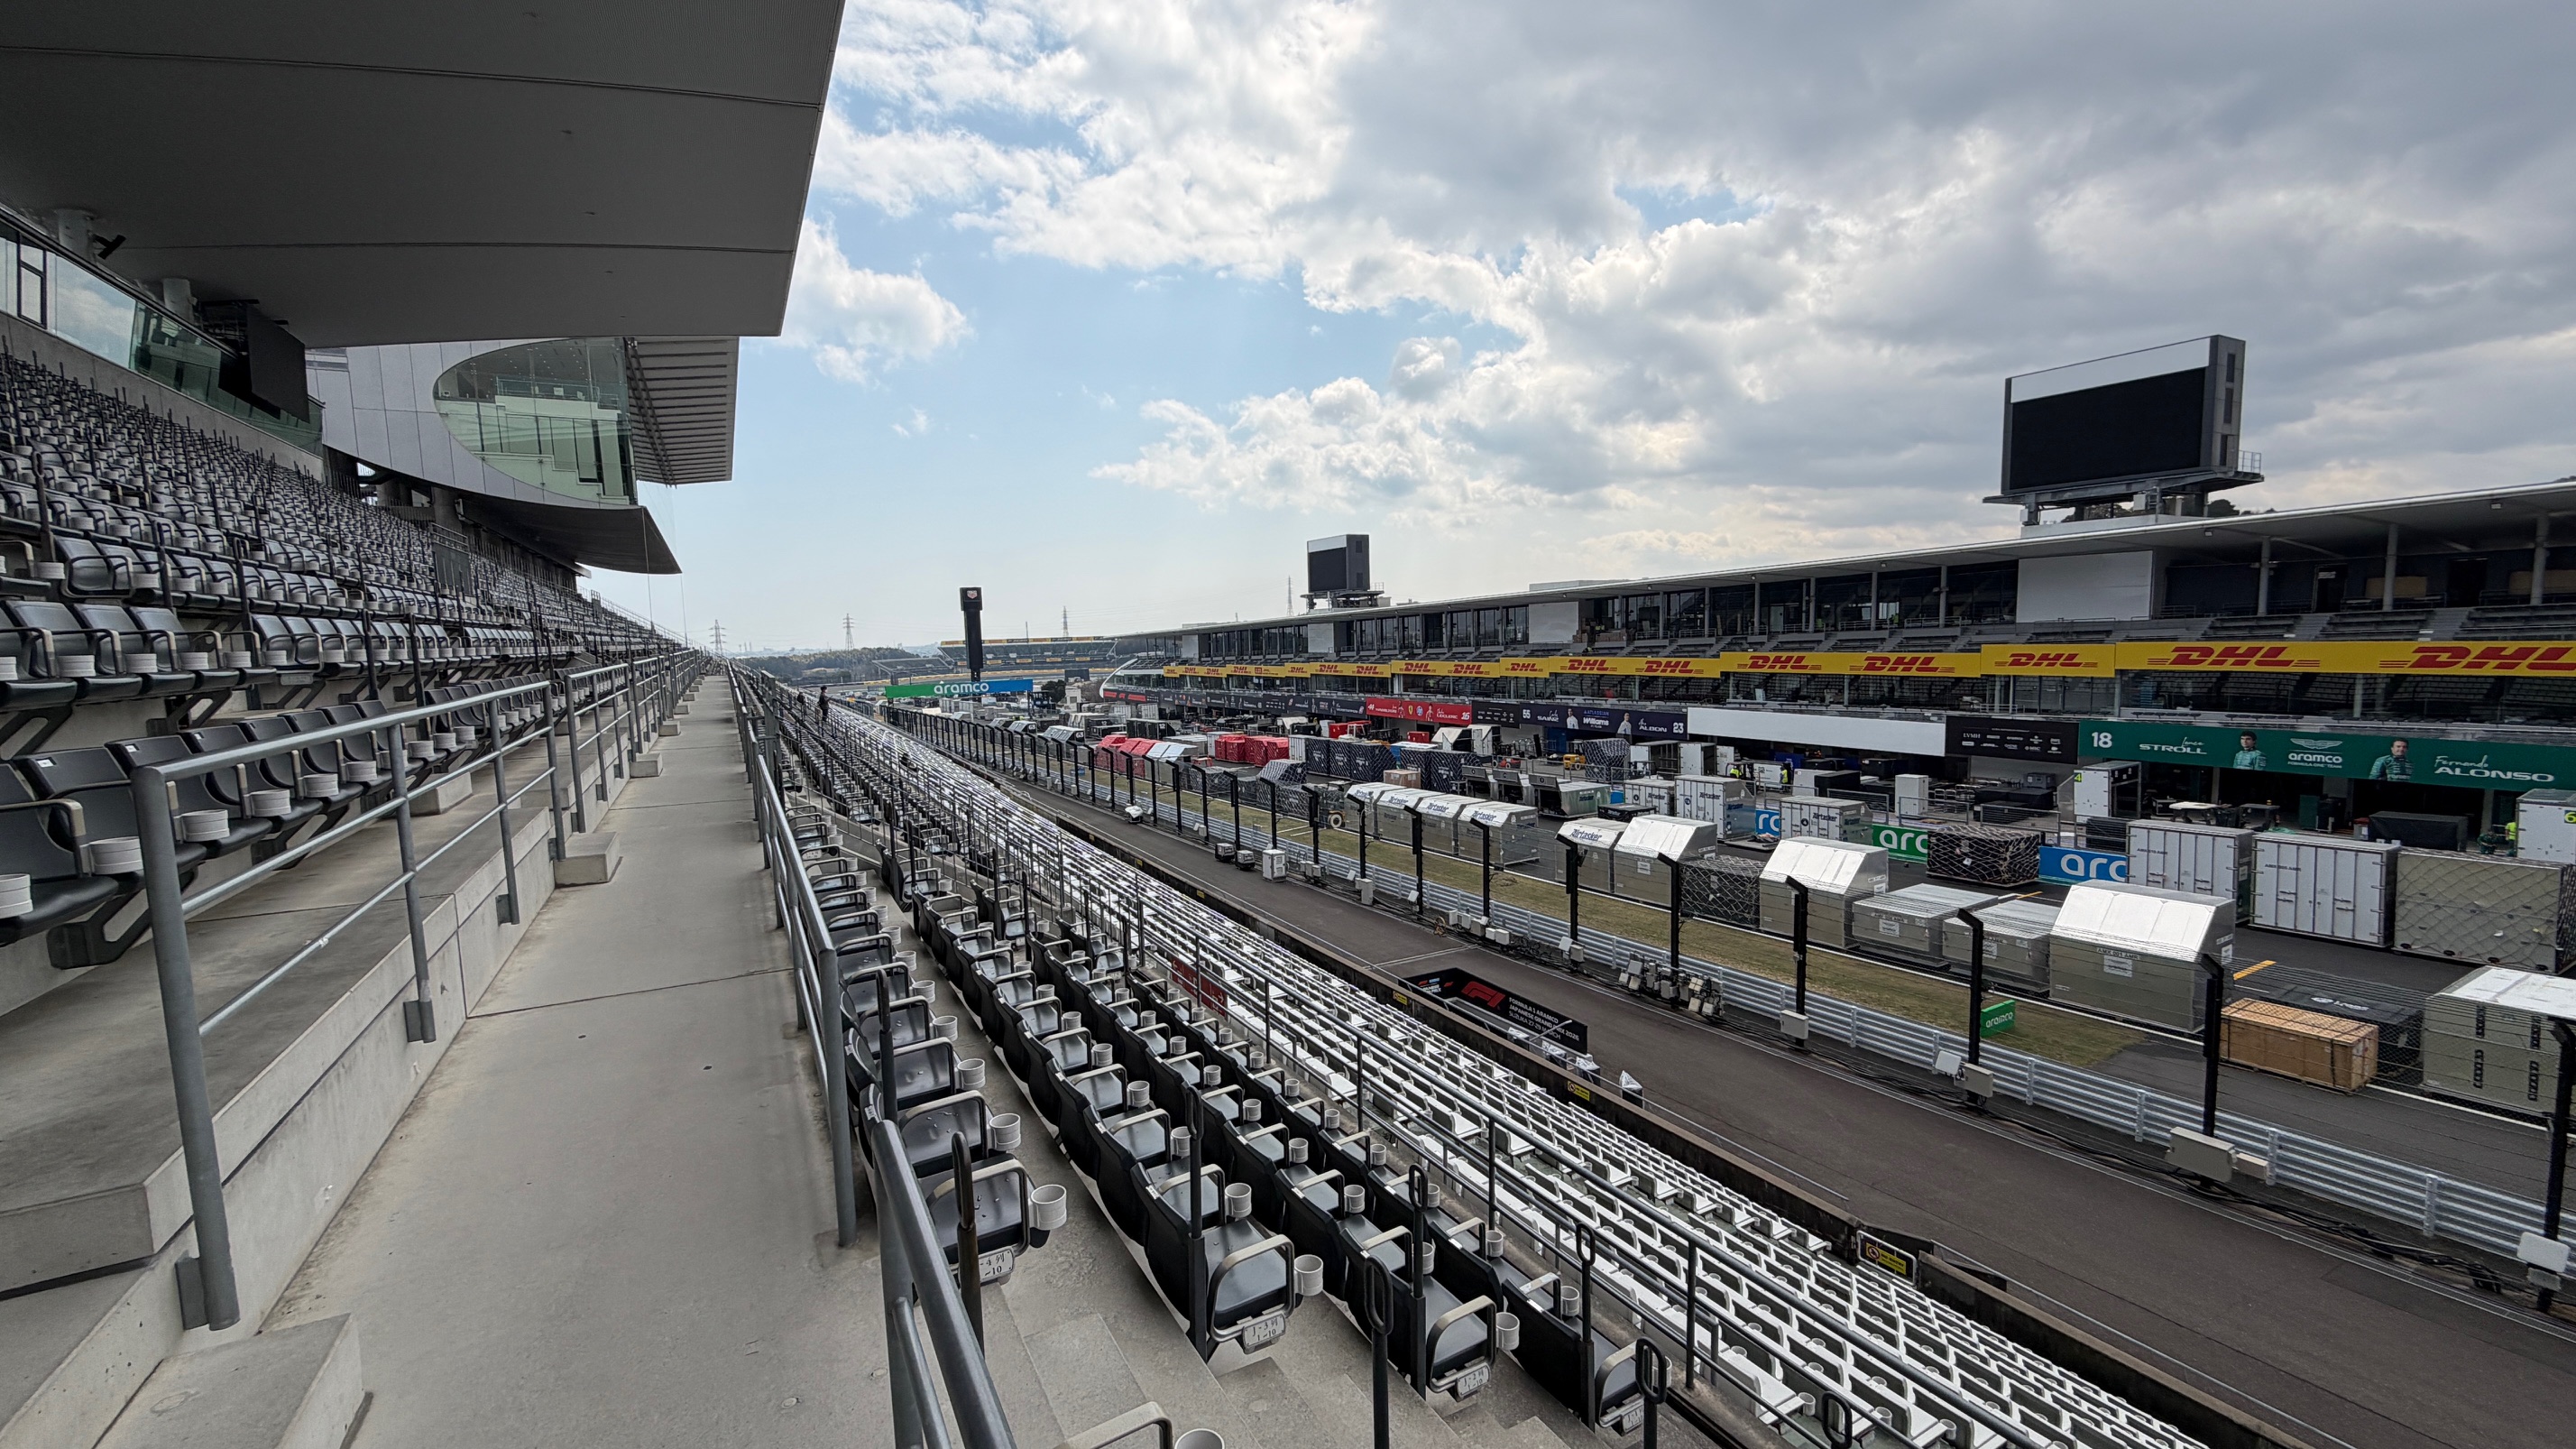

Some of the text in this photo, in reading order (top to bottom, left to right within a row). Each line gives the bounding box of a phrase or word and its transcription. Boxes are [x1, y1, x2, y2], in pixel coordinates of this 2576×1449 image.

[1746, 655, 1808, 670] DHL
[1863, 656, 1938, 672] DHL
[2007, 653, 2083, 668] DHL
[2167, 647, 2295, 668] DHL
[2407, 646, 2576, 670] DHL
[1356, 666, 1379, 674] DHL
[1403, 662, 1431, 672] DHL
[1453, 664, 1484, 674] DHL
[1510, 662, 1538, 671] DHL
[1568, 659, 1609, 670] DHL
[1644, 660, 1694, 673] DHL
[934, 681, 989, 695] aramco
[1460, 712, 1470, 720] 16
[1523, 709, 1531, 719] 55
[1583, 717, 1609, 726] Williams
[1673, 722, 1684, 734] 23
[2092, 732, 2112, 748] 18
[2139, 743, 2207, 755] STROLL
[2287, 752, 2343, 764] aramco
[2434, 754, 2489, 769] Fernando
[2433, 766, 2555, 782] ALONSO
[1472, 810, 1497, 822] Airtasker
[1812, 812, 1838, 824] Airtasker
[1570, 828, 1603, 842] Airtasker
[1509, 997, 1532, 1012] FORMULA
[1536, 1010, 1559, 1024] ARAMCO
[1509, 1004, 1534, 1020] JAPANESE
[1534, 1015, 1553, 1029] GRAND
[1509, 1011, 1528, 1024] SUZUKA
[1541, 1026, 1561, 1040] MRCH
[1985, 1011, 2013, 1028] aramco
